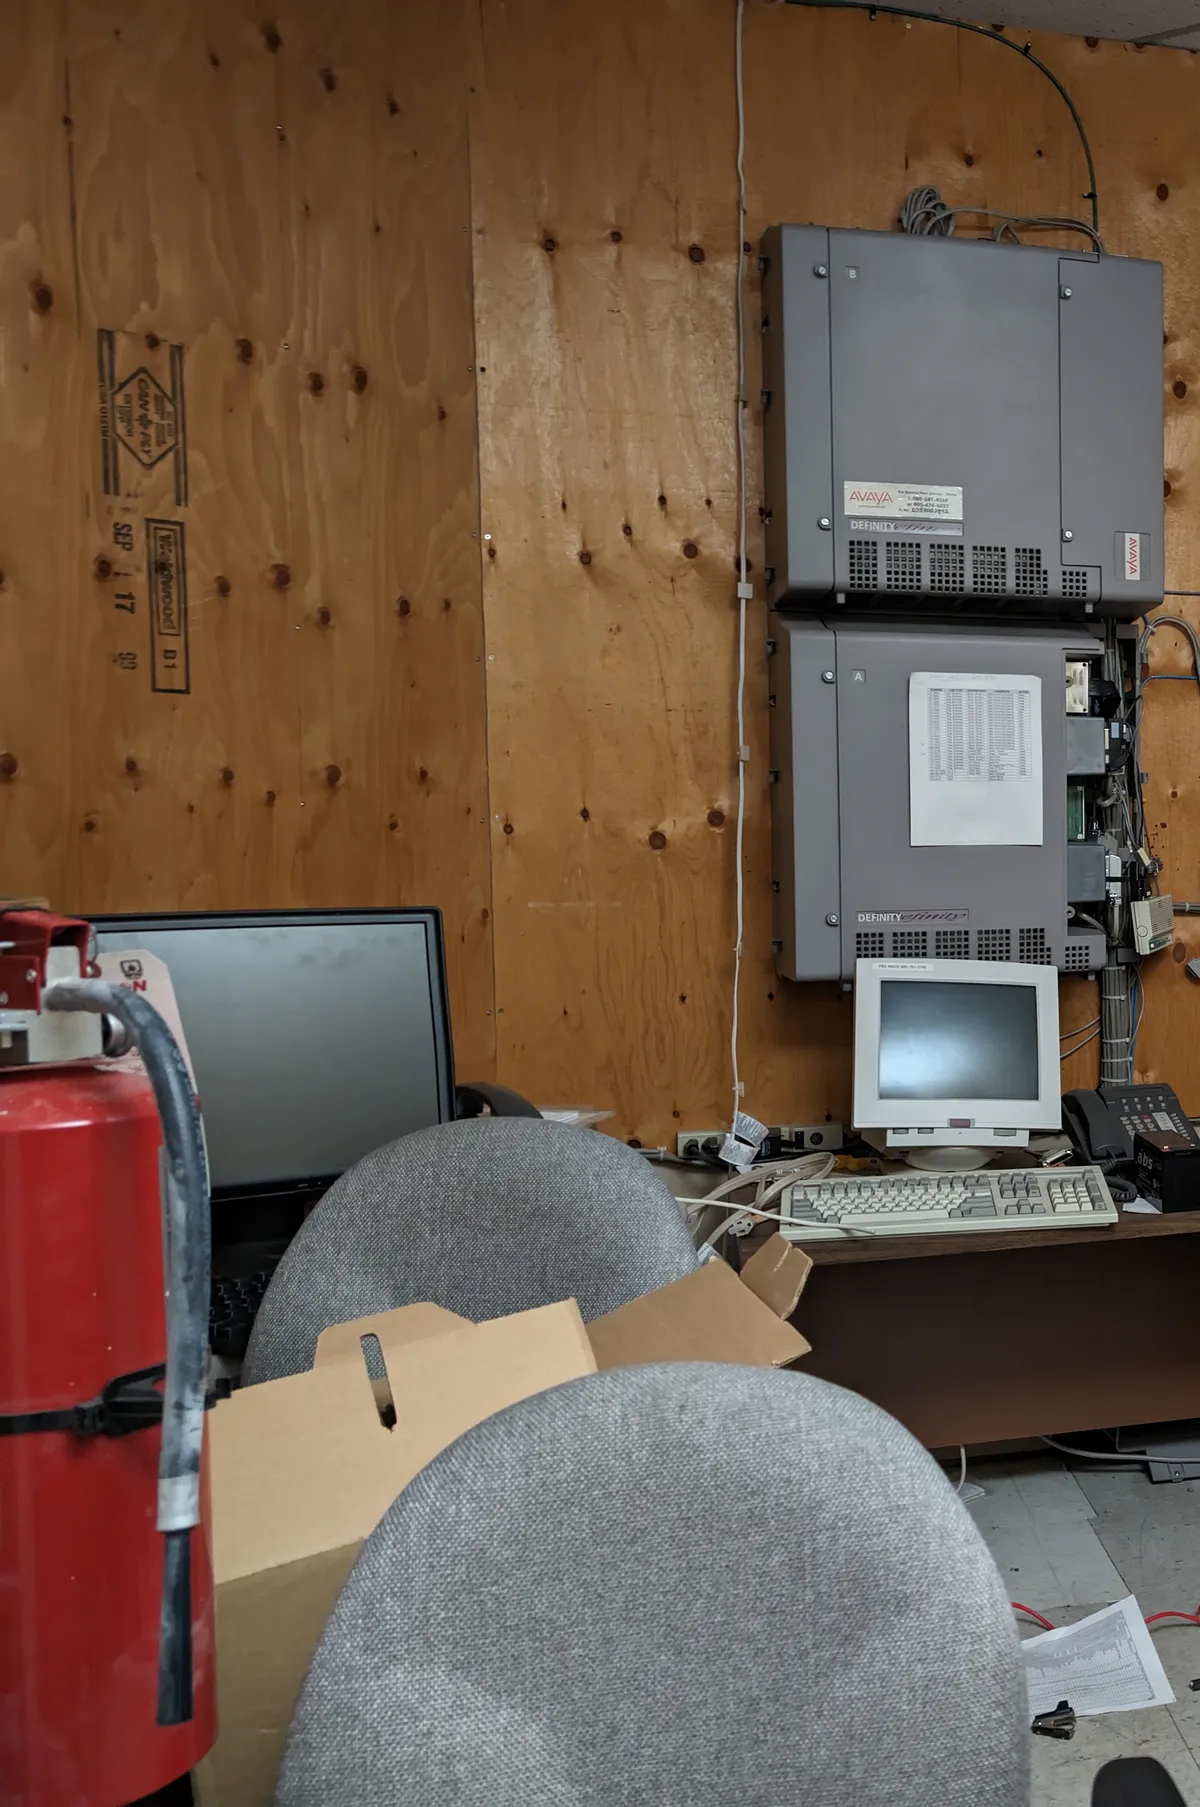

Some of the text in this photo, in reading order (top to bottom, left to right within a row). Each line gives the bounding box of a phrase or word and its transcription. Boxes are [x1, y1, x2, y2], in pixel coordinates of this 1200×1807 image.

[849, 490, 894, 505] AVAYA
[850, 520, 896, 531] DEFINITY
[112, 522, 134, 552] SEP
[1126, 536, 1138, 576] AVAYA
[158, 533, 176, 630] Weldwood
[114, 591, 136, 615] 17
[854, 671, 863, 681] A
[857, 913, 902, 923] DEFINITY
[1137, 1151, 1153, 1170] abs
